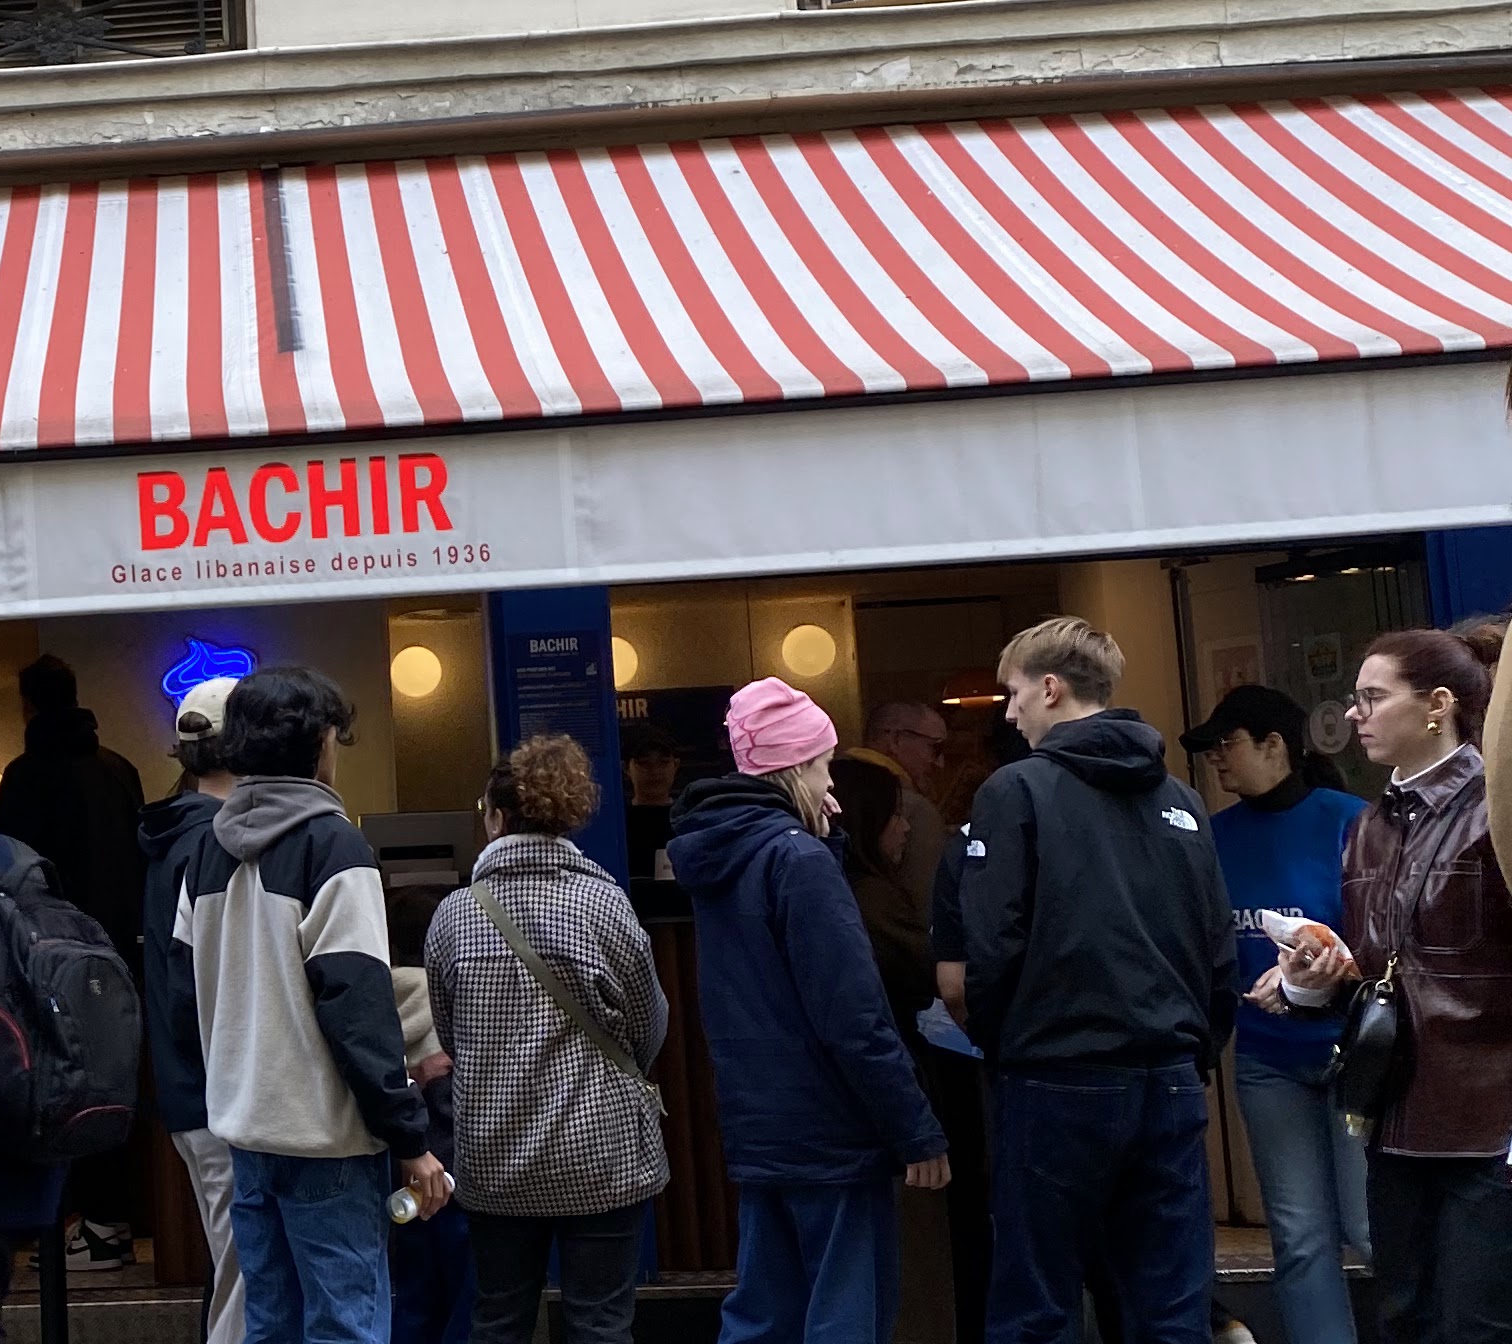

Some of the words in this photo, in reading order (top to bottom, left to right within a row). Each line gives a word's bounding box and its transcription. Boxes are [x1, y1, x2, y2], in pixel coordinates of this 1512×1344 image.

[137, 452, 454, 551] BACHIR
[111, 564, 183, 584] Glace
[196, 555, 316, 580] libanaise
[331, 548, 418, 575] depuis
[432, 543, 491, 566] 1936
[529, 637, 579, 653] BACHIR
[615, 697, 649, 719] HIR
